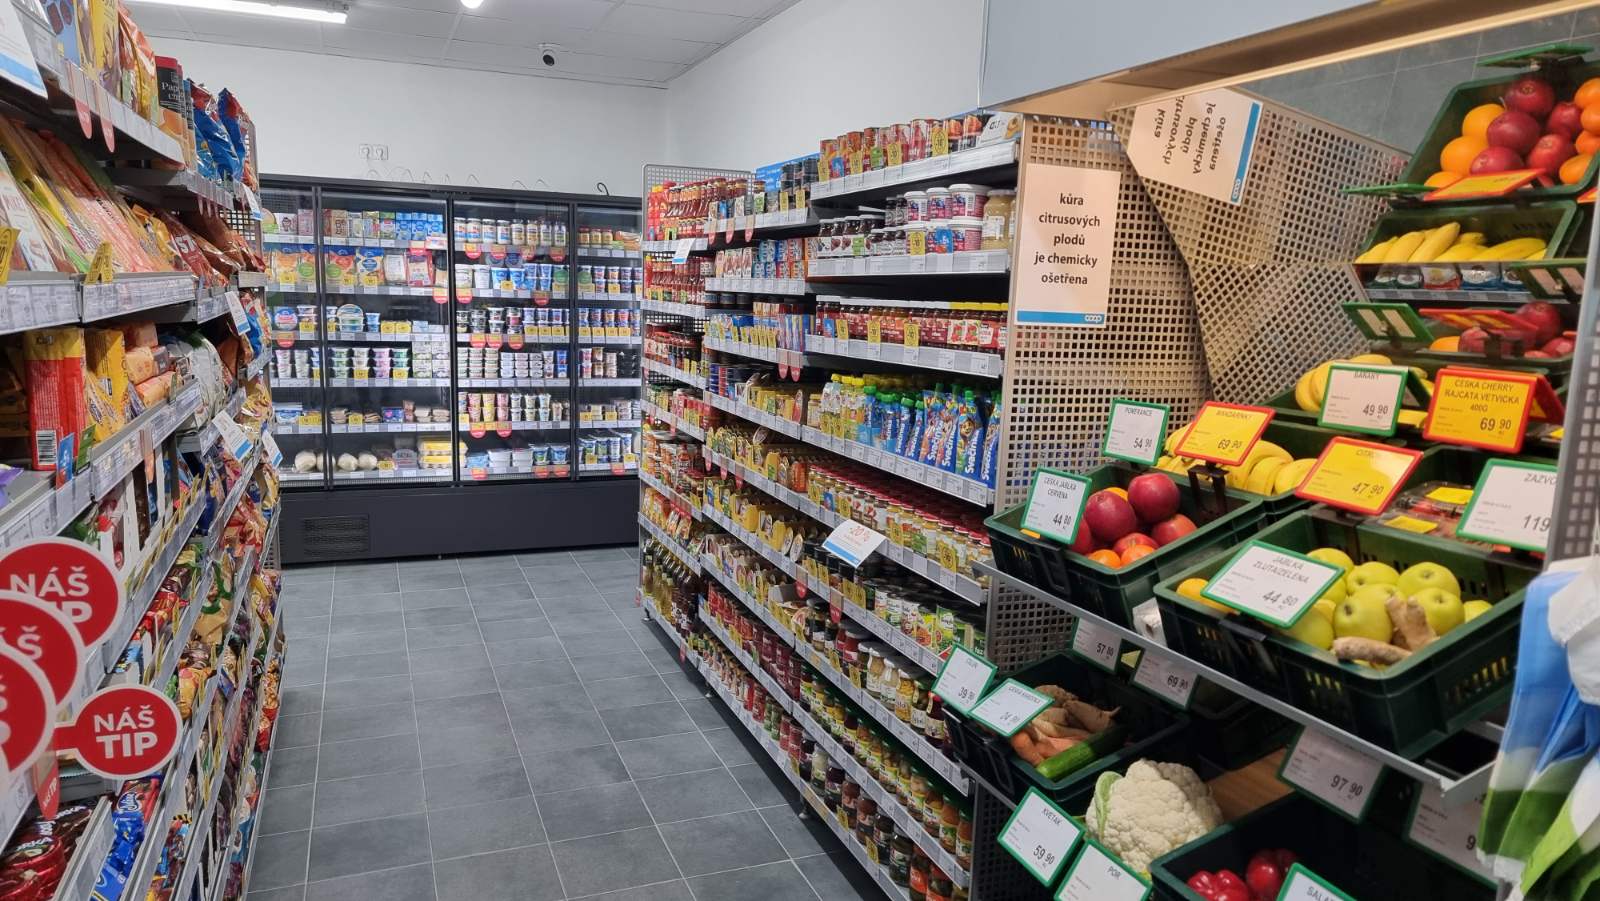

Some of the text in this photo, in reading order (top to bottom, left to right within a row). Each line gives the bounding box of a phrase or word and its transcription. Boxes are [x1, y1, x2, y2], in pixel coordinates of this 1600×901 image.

[1059, 193, 1084, 206] kůra
[1038, 212, 1101, 228] citrusových
[1053, 228, 1085, 247] plodů
[1034, 251, 1098, 269] je chemicky
[1041, 270, 1088, 286] ošetřena
[1481, 381, 1515, 393] CHERRY
[1445, 389, 1520, 405] RAJCATA VETVICKA
[1362, 403, 1389, 416] 49 90
[1480, 417, 1512, 432] 69 90
[1133, 437, 1144, 449] 54
[1217, 439, 1231, 450] 69
[1523, 473, 1558, 485] ZAZVO
[1352, 482, 1384, 496] 47 90
[1053, 513, 1063, 526] 44
[1523, 514, 1553, 532] 119
[10, 566, 90, 597] NÁŠ
[1262, 590, 1281, 604] 44
[1096, 643, 1106, 655] 57
[1167, 675, 1179, 688] 69
[958, 686, 968, 699] 39
[93, 704, 155, 733] NÁŠ
[96, 731, 158, 759] TIP
[1330, 773, 1364, 797] 97 90
[1033, 844, 1055, 865] 59 90
[1106, 865, 1122, 880] POR
